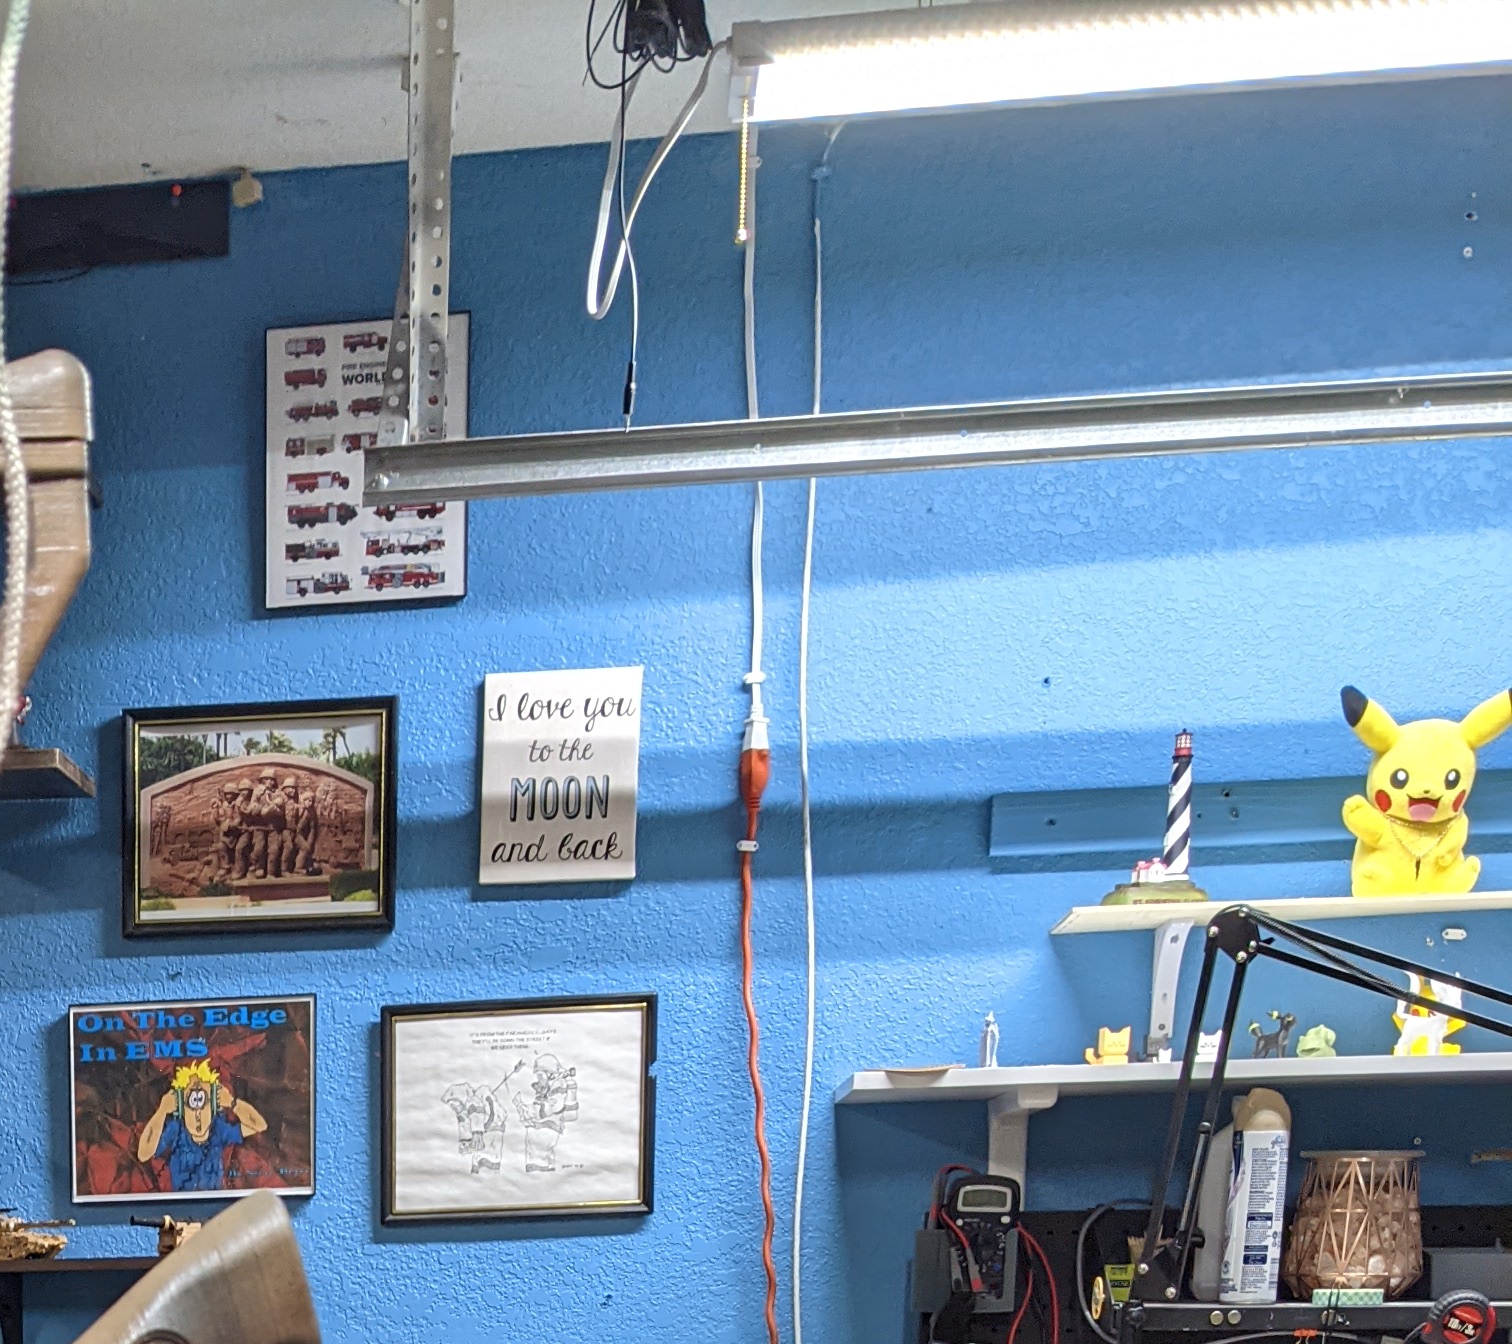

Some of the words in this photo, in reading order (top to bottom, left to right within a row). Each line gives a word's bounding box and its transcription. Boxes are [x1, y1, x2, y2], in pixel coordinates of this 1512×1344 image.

[488, 694, 507, 722] I
[518, 692, 576, 721] love
[584, 696, 637, 732] you
[528, 740, 555, 762] to
[558, 739, 595, 762] the
[509, 774, 610, 822] MOON
[491, 834, 548, 863] and
[558, 832, 624, 861] back
[77, 1014, 125, 1034] On
[131, 1010, 195, 1030] The
[203, 1006, 287, 1029] Edge
[79, 1043, 117, 1063] In
[124, 1038, 209, 1061] EMS
